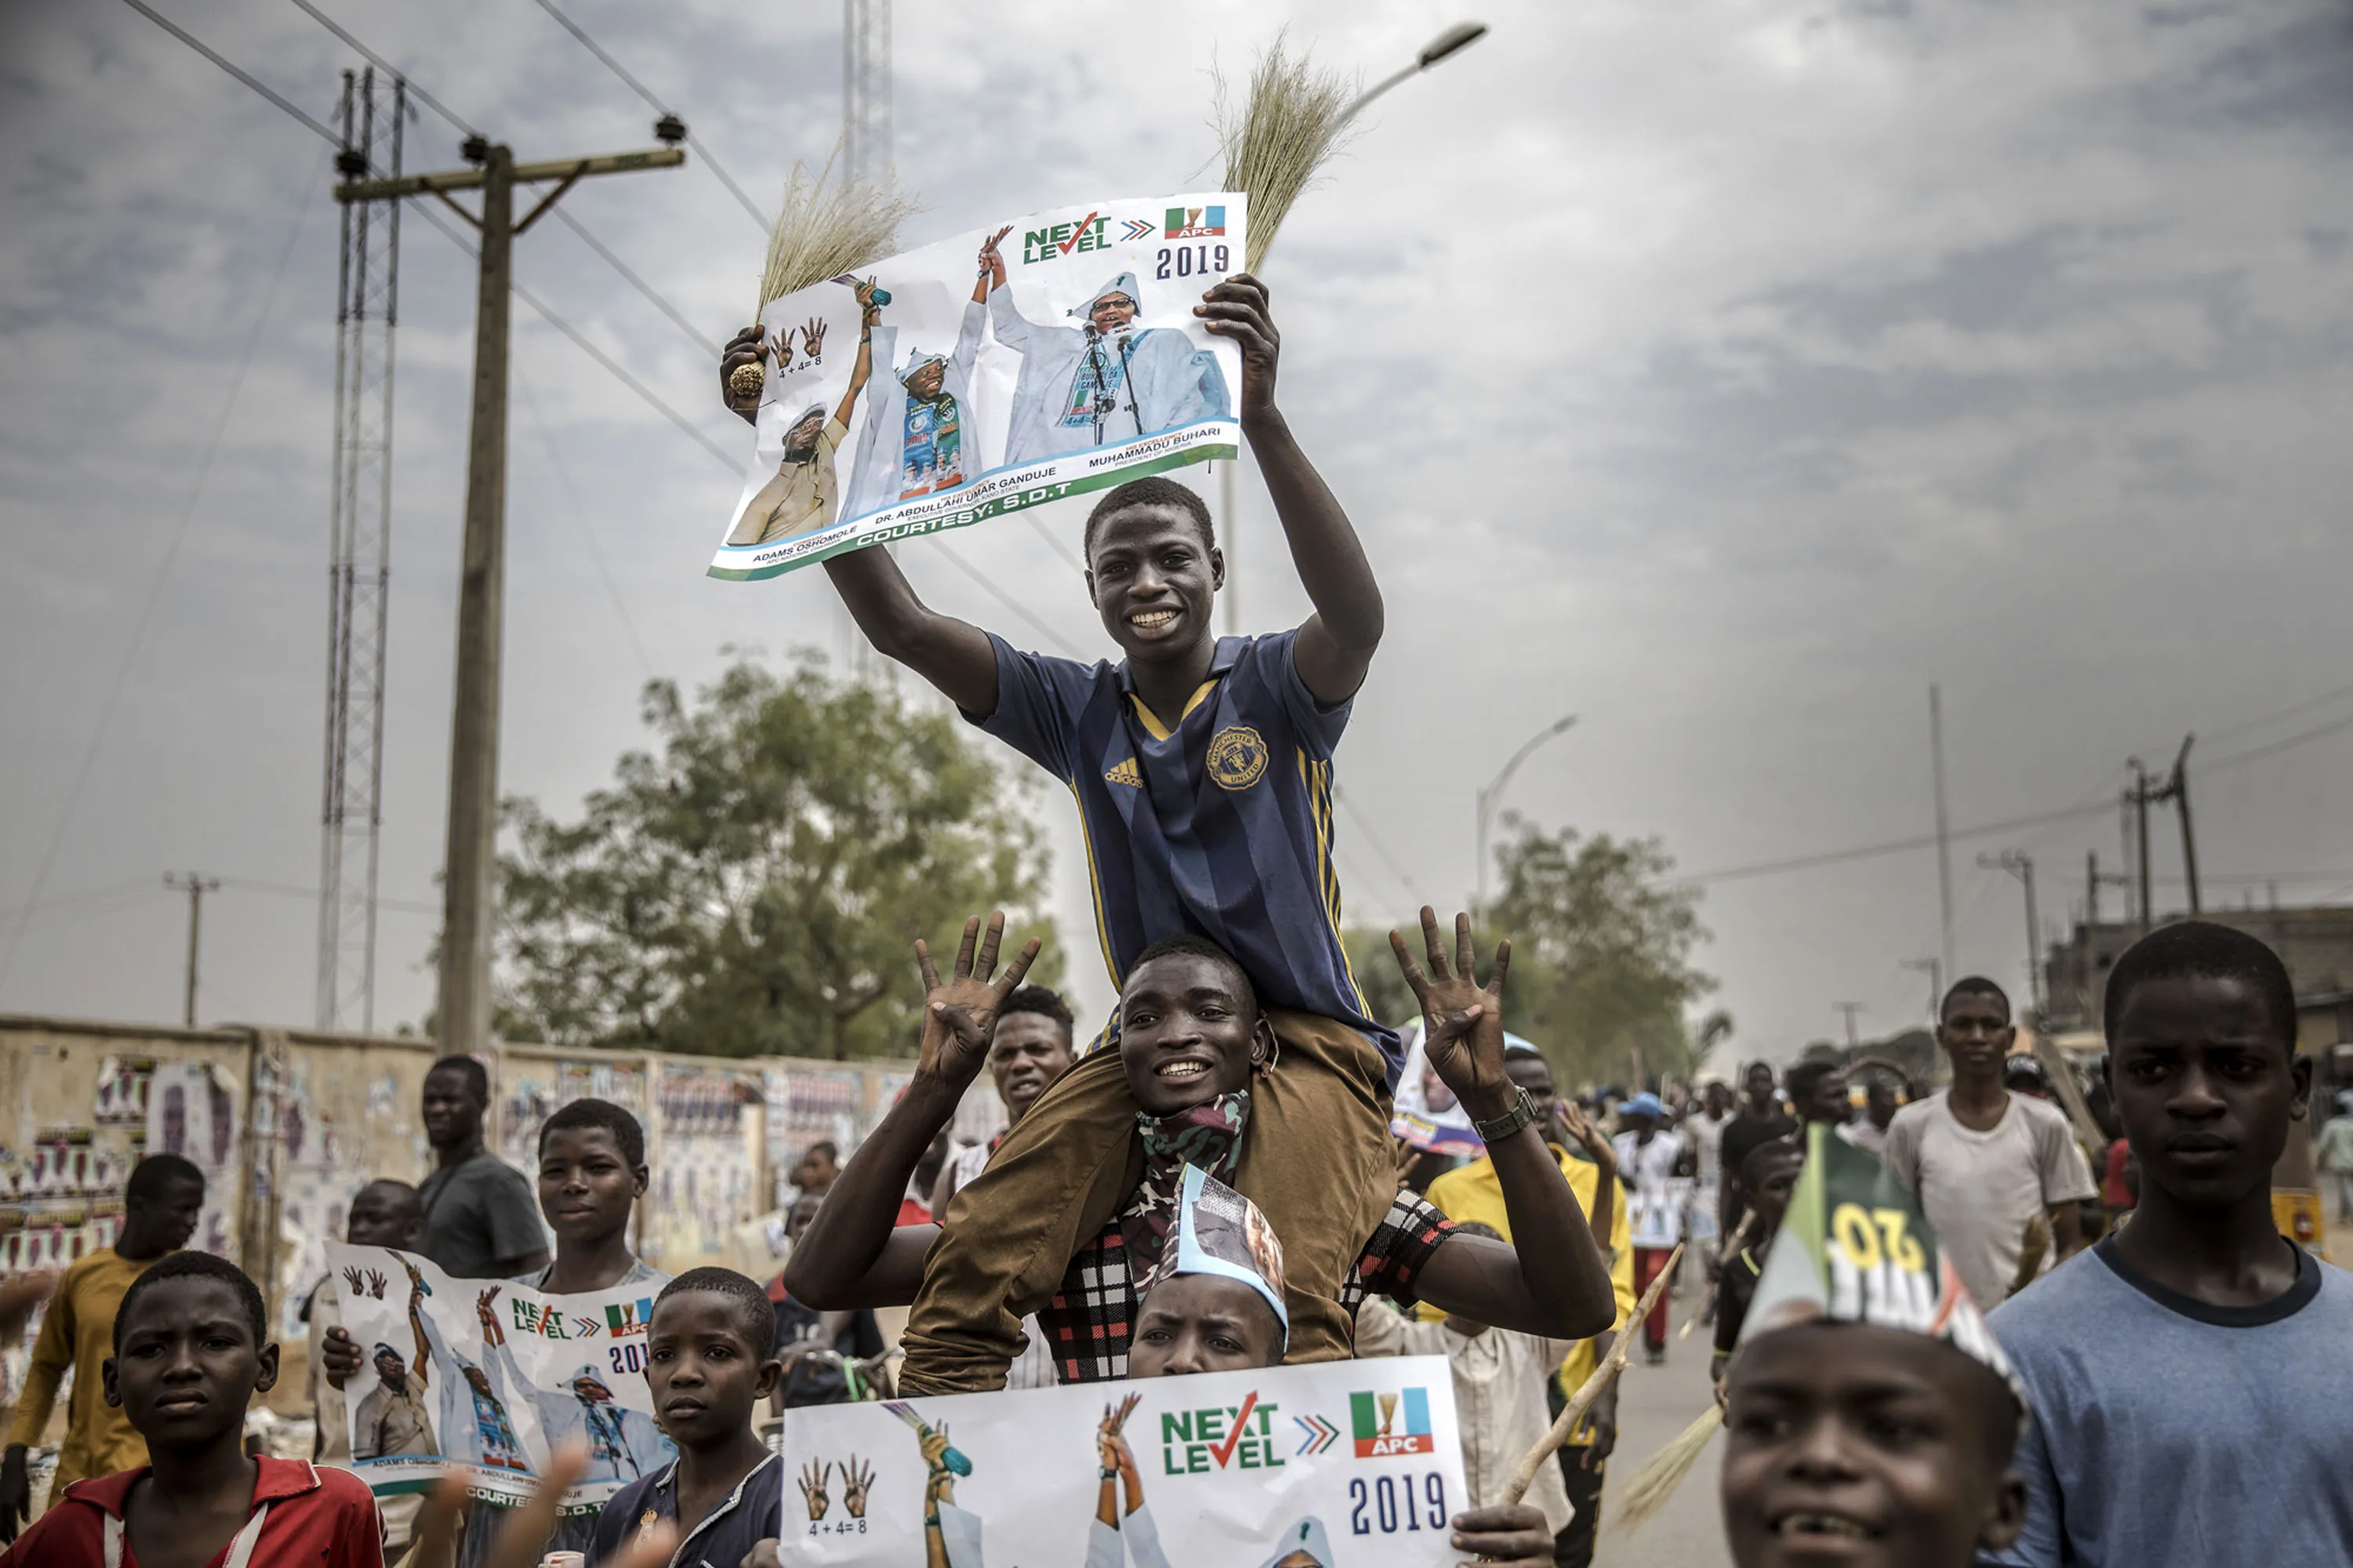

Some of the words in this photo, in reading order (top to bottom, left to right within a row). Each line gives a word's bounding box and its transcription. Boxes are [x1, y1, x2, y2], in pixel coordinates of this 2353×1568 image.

[1025, 212, 1111, 249] NEXT
[1178, 227, 1214, 238] APC
[1023, 234, 1112, 265] LEVEL
[1157, 245, 1229, 280] 2019
[815, 356, 822, 365] 8
[1089, 441, 1170, 467] MUHAMMADU
[1173, 428, 1221, 445] BUHARI
[1115, 452, 1153, 466] PRESIDENT
[875, 514, 894, 524] DR.
[896, 497, 964, 518] ABDULLAHI
[967, 482, 997, 502] UMAR
[999, 466, 1057, 488] GANDUJE
[856, 504, 993, 546] COURTESY:
[1003, 482, 1072, 510] S.D.T
[753, 547, 793, 562] ADAMS
[797, 525, 858, 550] OSHOMOLE
[1213, 735, 1252, 763] MANCHESTER
[1105, 772, 1143, 788] adidas
[1231, 764, 1259, 782] UNITED
[512, 1298, 563, 1327] NEXT
[514, 1315, 572, 1340] LEVEL
[609, 1343, 650, 1374] 201
[1160, 1392, 1278, 1443] NEXT
[1163, 1439, 1286, 1475] LEVEL
[1371, 1436, 1418, 1455] APC
[1349, 1471, 1447, 1535] 2019
[809, 1523, 818, 1537] 4
[858, 1519, 867, 1534] 8
